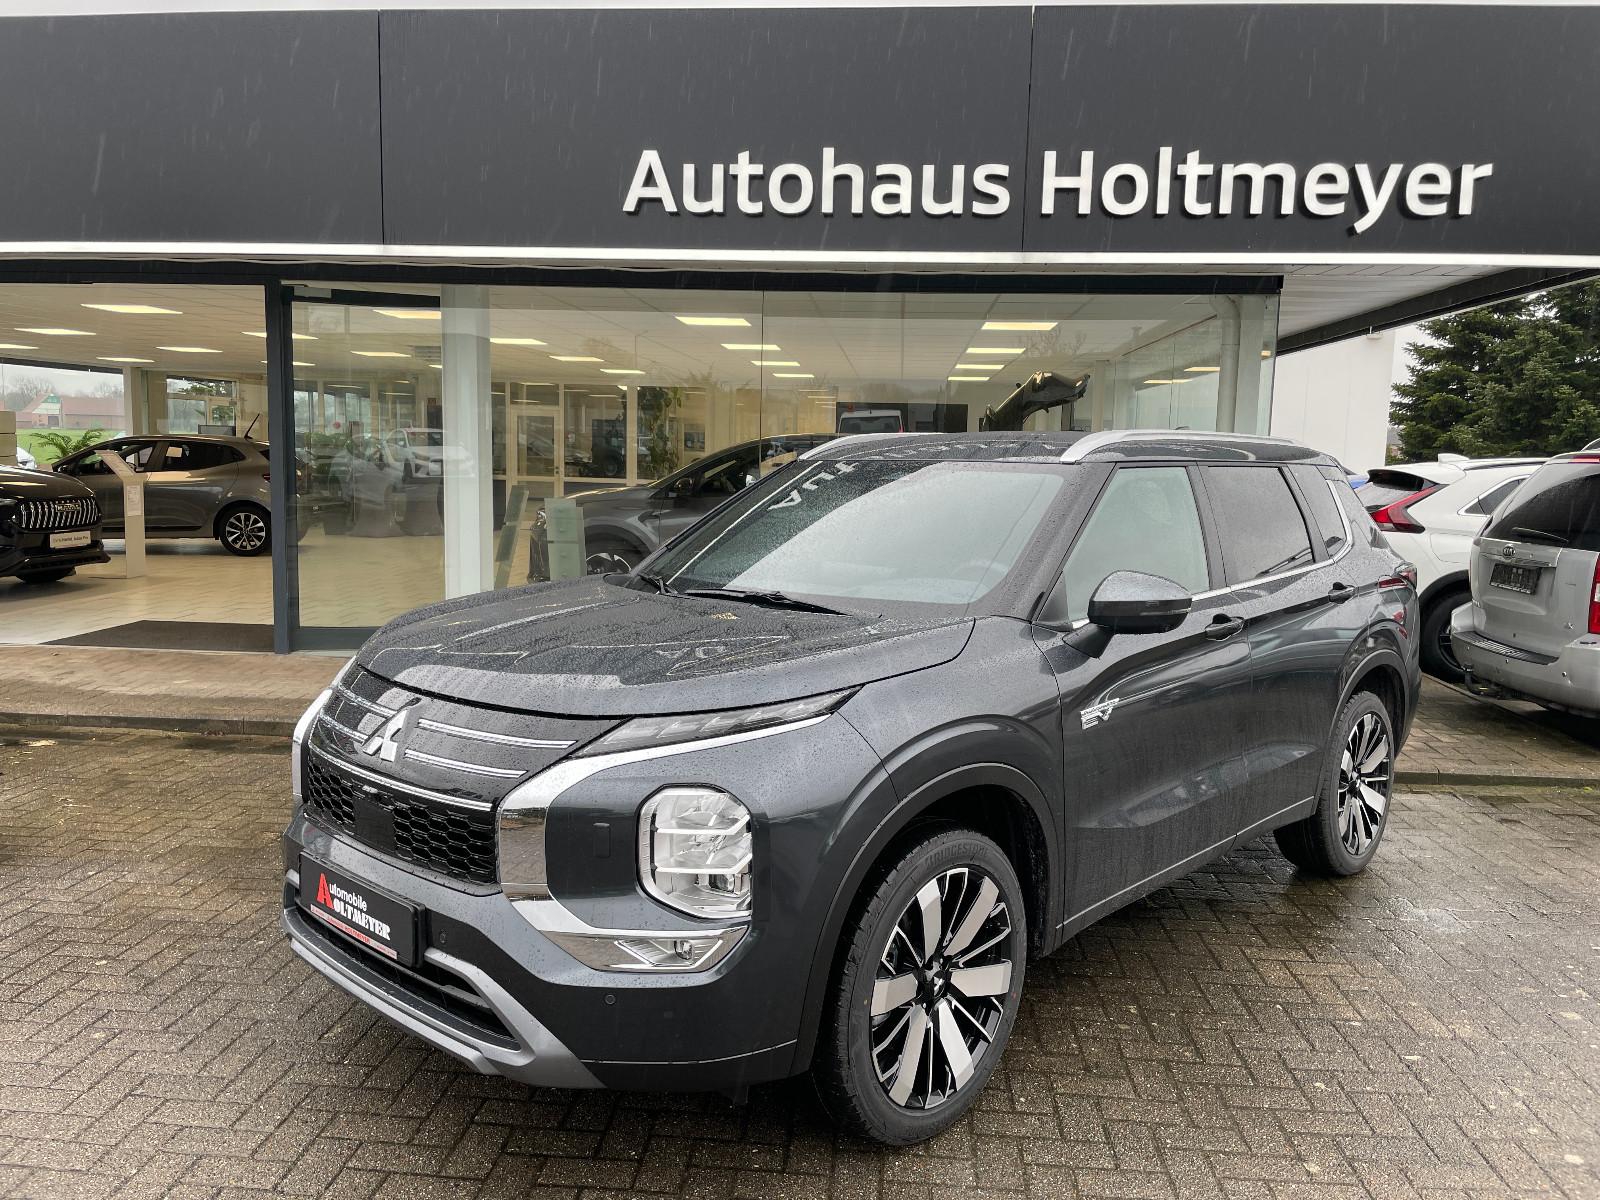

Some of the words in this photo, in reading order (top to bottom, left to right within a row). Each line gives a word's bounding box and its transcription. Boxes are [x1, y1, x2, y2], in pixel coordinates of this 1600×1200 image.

[622, 147, 1011, 216] Autohaus
[1040, 146, 1493, 235] Holtmeyer
[316, 873, 367, 911] Automobile
